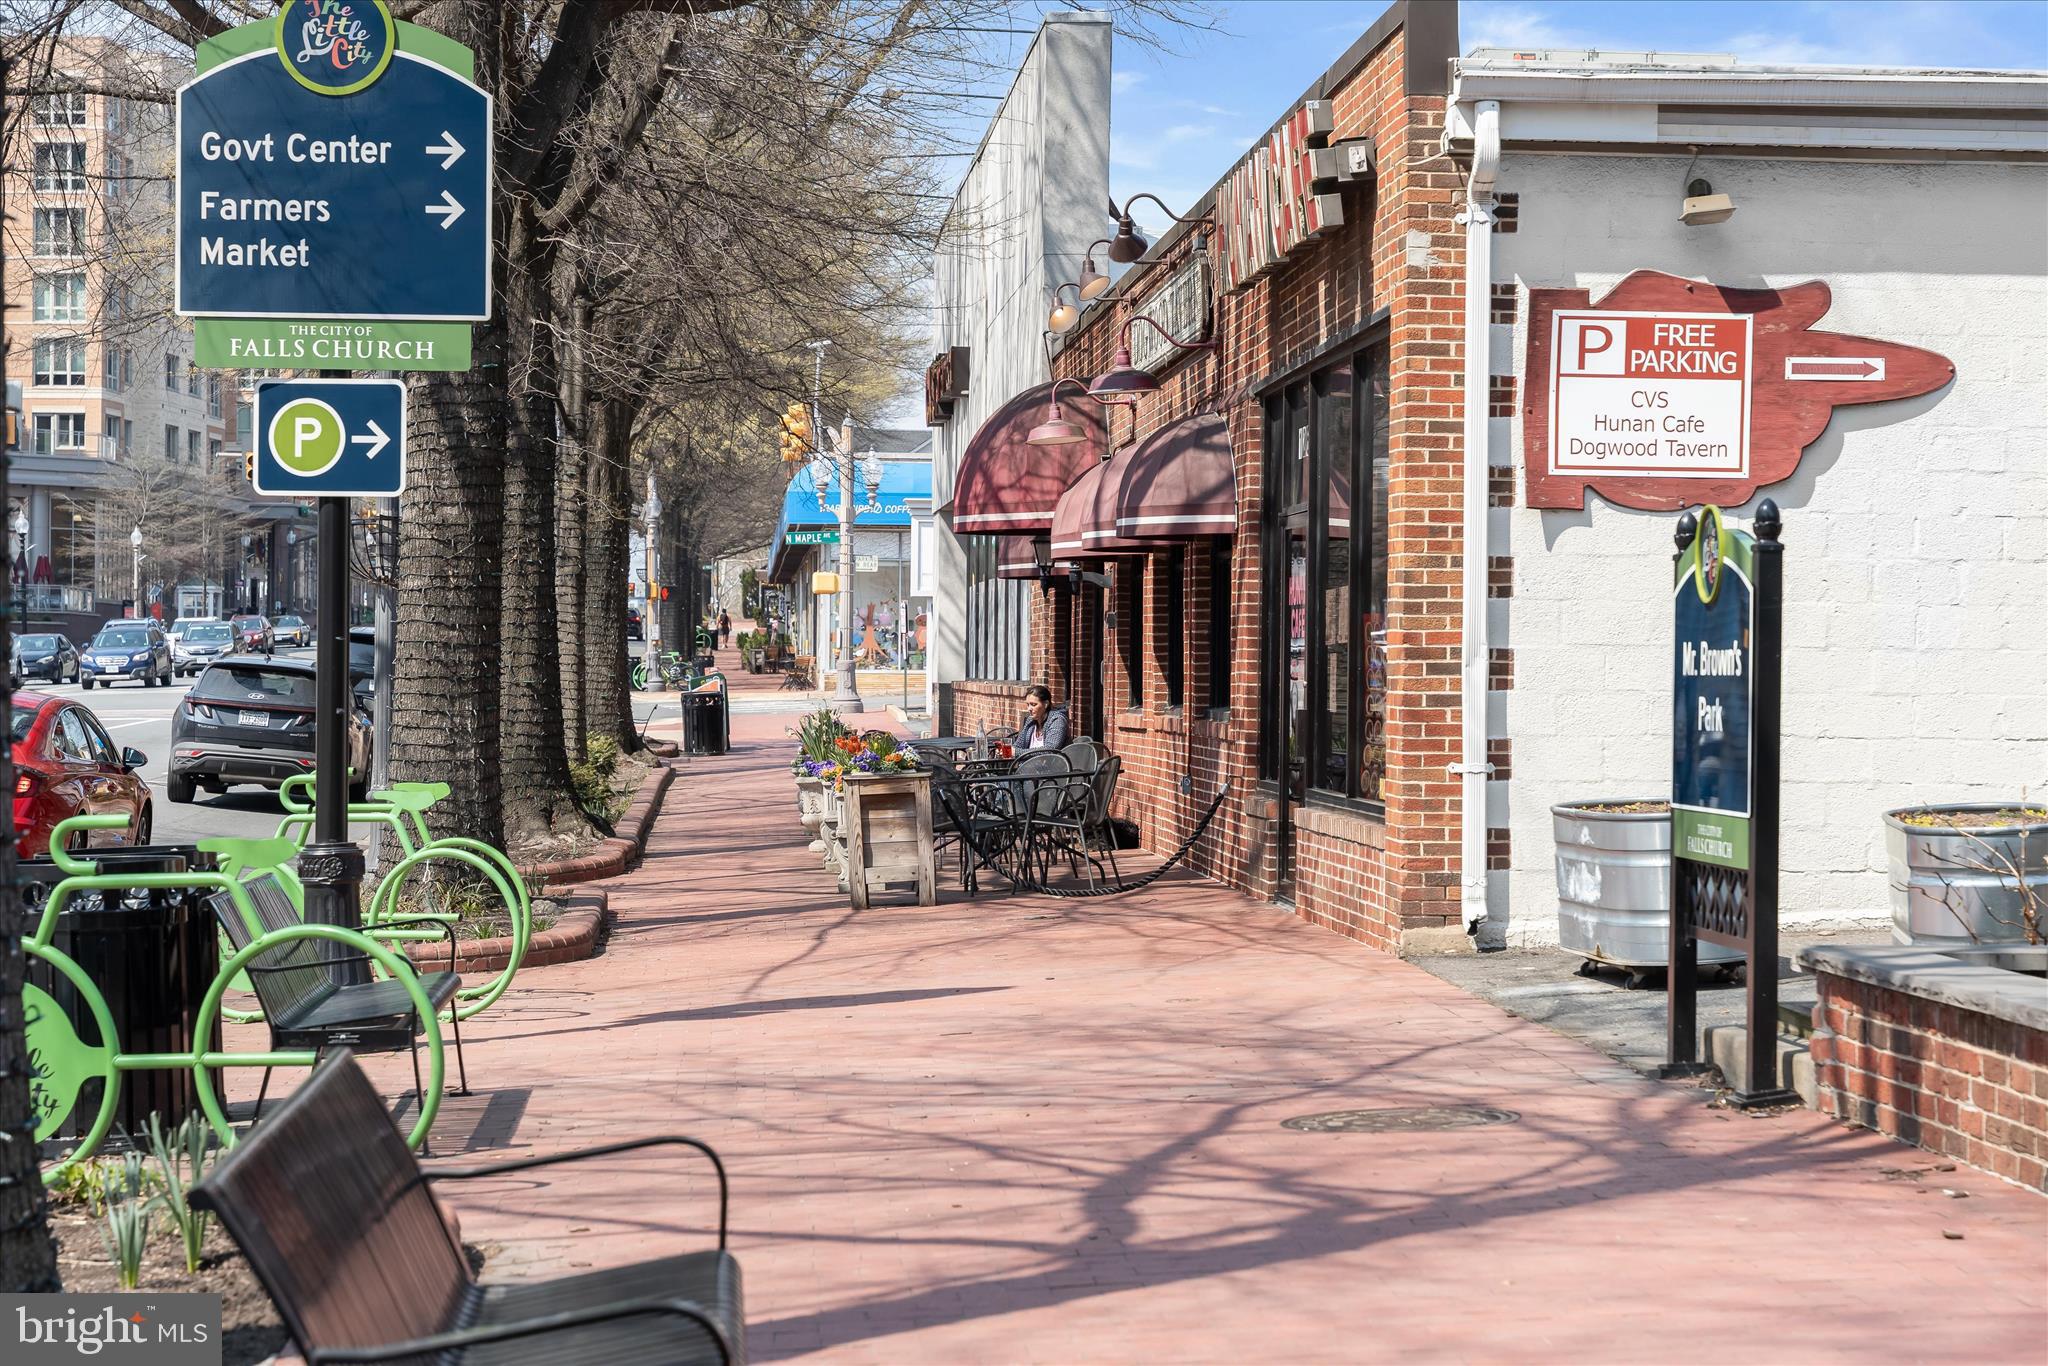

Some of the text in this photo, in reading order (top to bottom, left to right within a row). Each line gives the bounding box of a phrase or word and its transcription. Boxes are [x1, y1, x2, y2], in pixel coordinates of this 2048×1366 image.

[296, 14, 371, 63] Little
[331, 37, 375, 70] City
[200, 131, 392, 164] Govt Center
[200, 191, 331, 222] Farmers
[200, 236, 310, 267] Market
[289, 325, 373, 336] THE CITY OF
[1654, 323, 1716, 347] FREE
[230, 338, 435, 359] FALLS CHURCH
[1577, 324, 1613, 370] P
[1630, 349, 1737, 374] PARKING
[1631, 390, 1669, 408] CVS
[294, 417, 322, 458] P
[1594, 414, 1705, 433] Hunan Cafe
[1570, 438, 1728, 460] Dogwood Tavern
[785, 534, 792, 544] N
[795, 533, 822, 543] MAPLE
[1700, 640, 1742, 677] Brown's
[1698, 696, 1723, 732] Park
